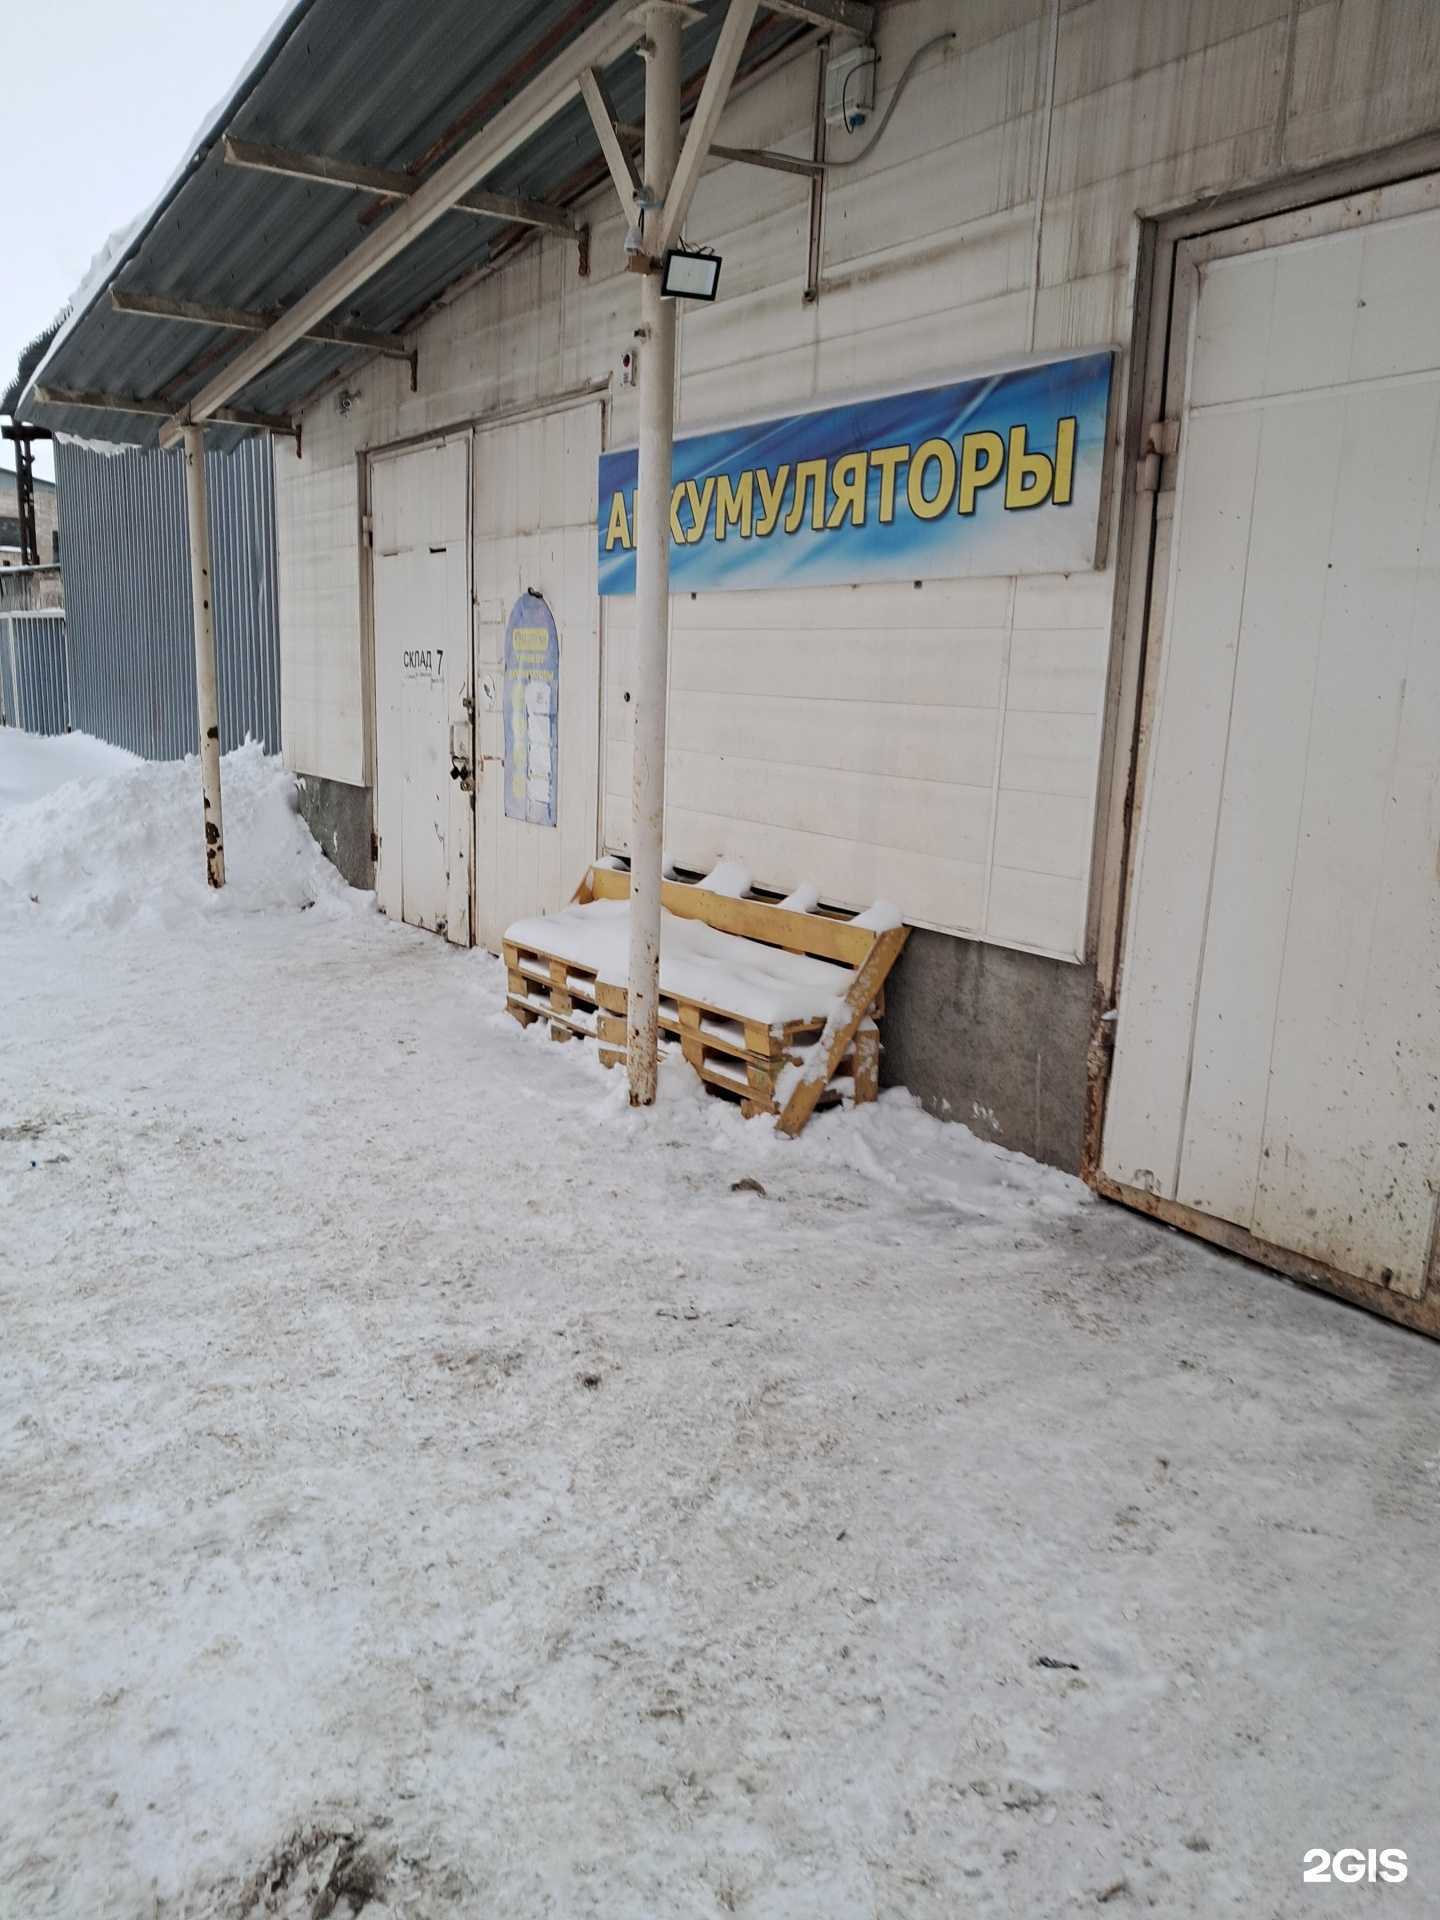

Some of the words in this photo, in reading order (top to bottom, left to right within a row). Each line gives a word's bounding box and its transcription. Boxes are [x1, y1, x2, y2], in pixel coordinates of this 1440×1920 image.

[605, 416, 1078, 552] АКУМУЛЯТОРЫ
[403, 649, 432, 671] СКЛАД
[436, 649, 444, 675] 7
